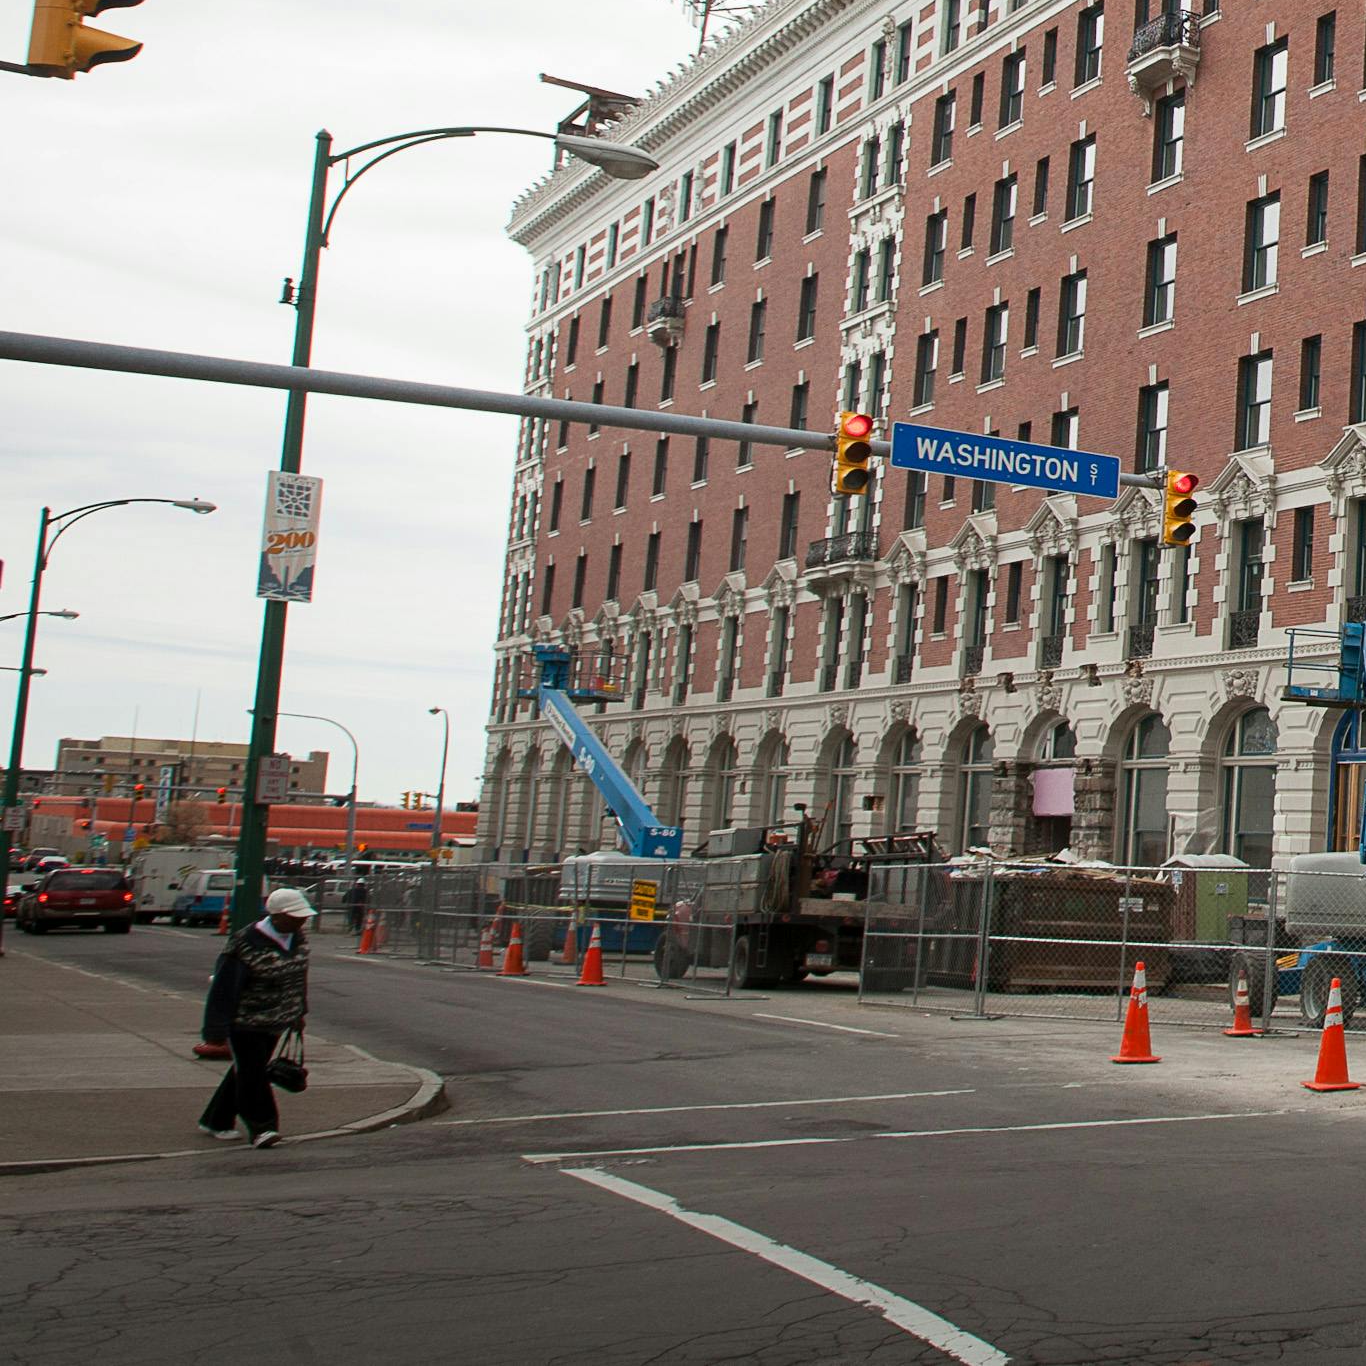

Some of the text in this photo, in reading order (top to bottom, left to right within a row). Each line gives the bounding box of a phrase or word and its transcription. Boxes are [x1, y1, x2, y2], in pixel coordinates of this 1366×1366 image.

[916, 436, 1099, 486] WASHINGTON ST
[266, 531, 316, 555] 200
